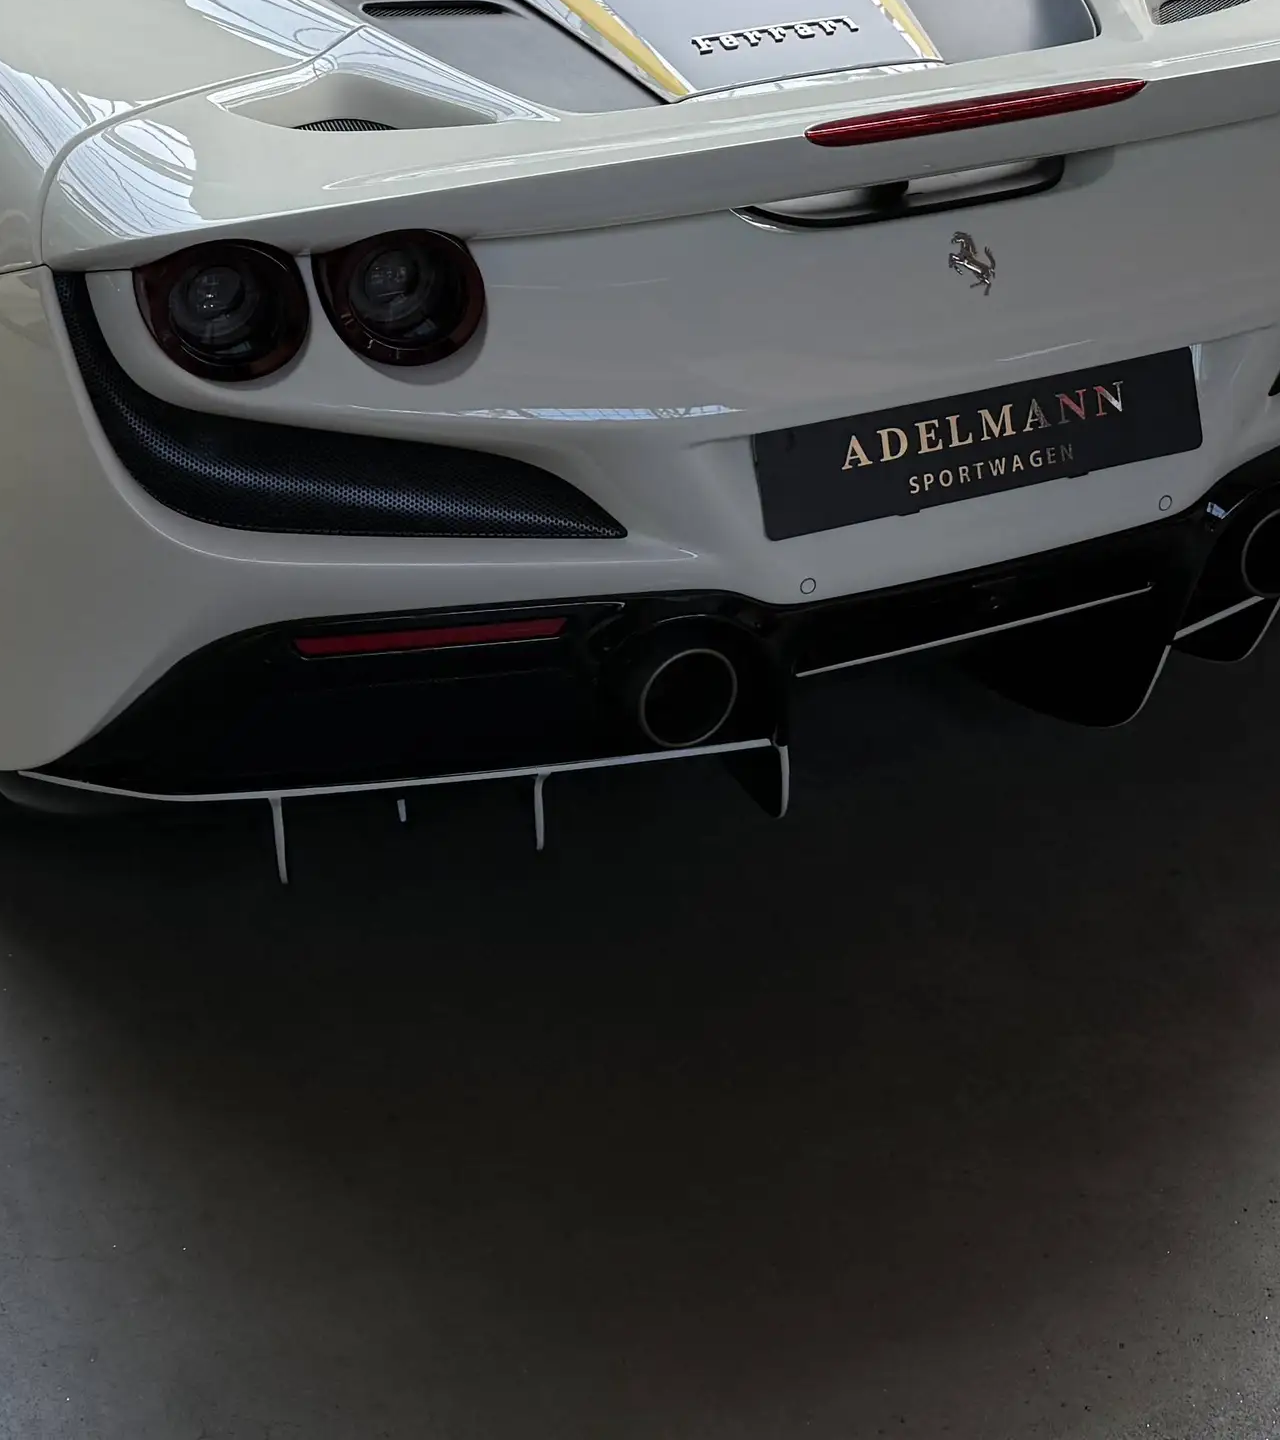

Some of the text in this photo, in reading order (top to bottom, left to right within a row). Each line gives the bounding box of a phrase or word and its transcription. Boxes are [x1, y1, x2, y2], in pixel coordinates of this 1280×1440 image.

[691, 16, 861, 55] Ferrari
[841, 380, 1124, 471] ADELMANN
[908, 442, 1075, 495] SPORTWAGEN
